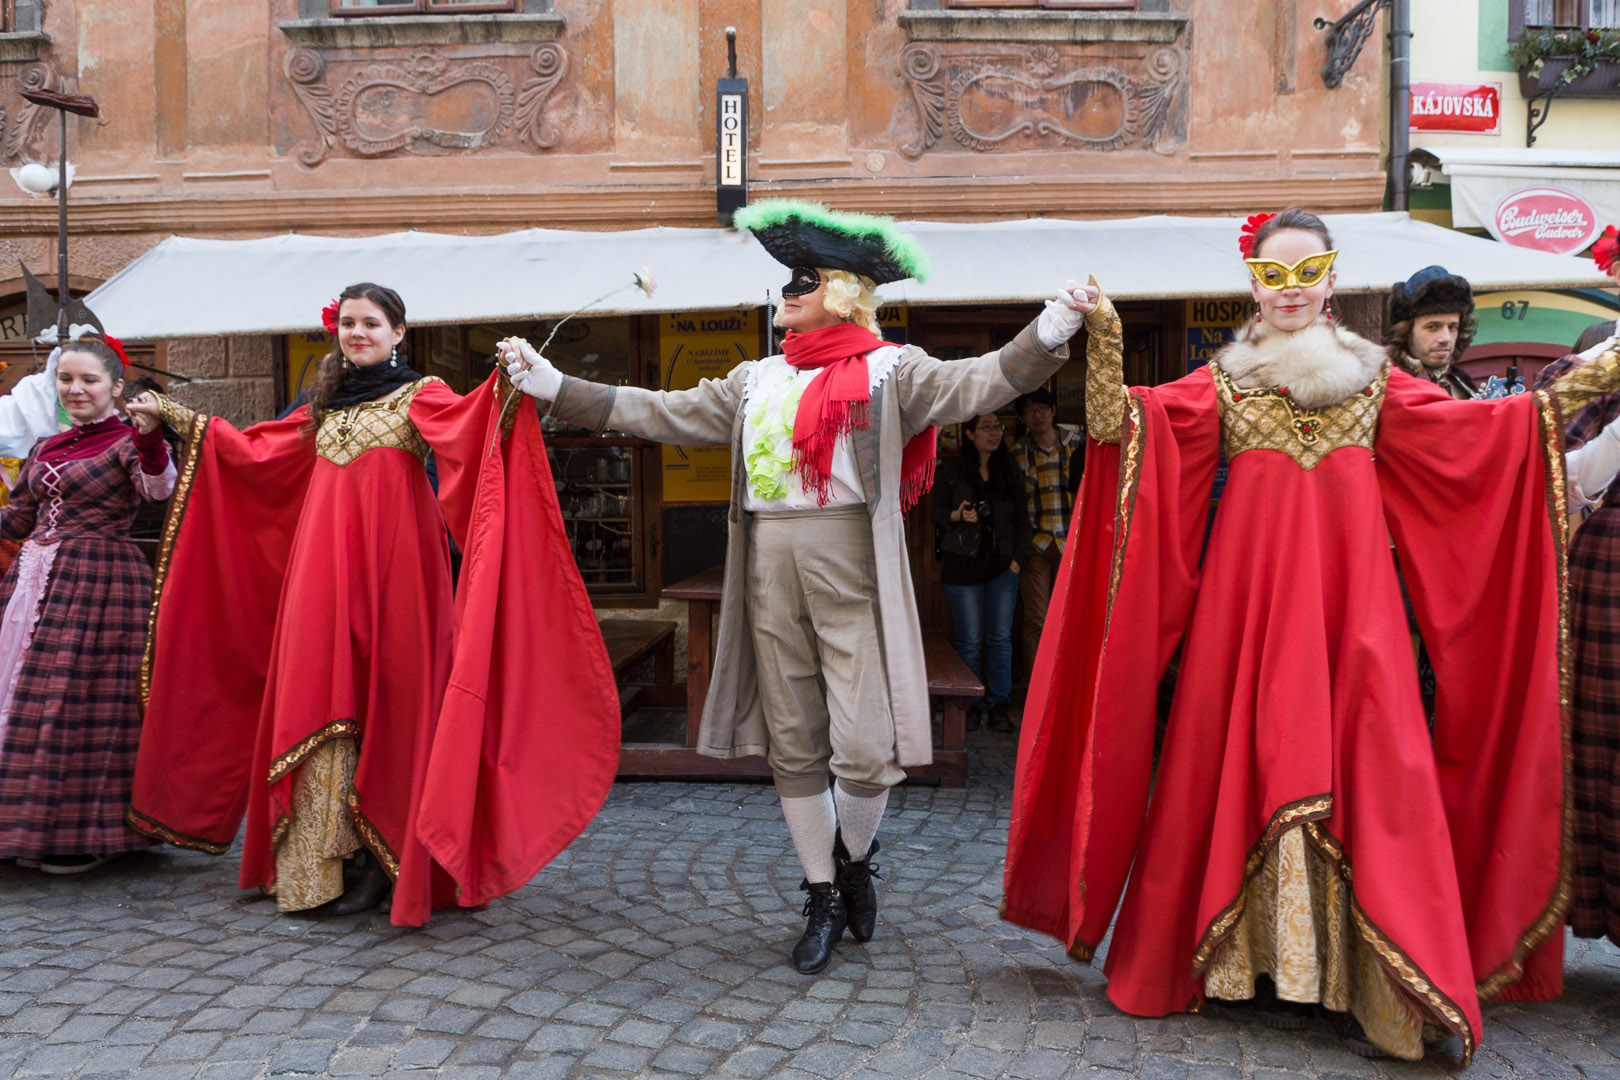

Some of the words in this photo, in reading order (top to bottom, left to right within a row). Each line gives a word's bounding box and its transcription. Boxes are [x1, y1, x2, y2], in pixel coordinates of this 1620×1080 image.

[1411, 90, 1494, 117] KÁJOVSKÁ
[724, 100, 738, 179] HOTEL
[1501, 205, 1588, 237] Budweiser
[1535, 223, 1586, 239] Budvar
[1501, 300, 1530, 320] 67
[677, 320, 696, 332] NA
[701, 316, 741, 331] LOUŽI
[1201, 327, 1223, 344] Na
